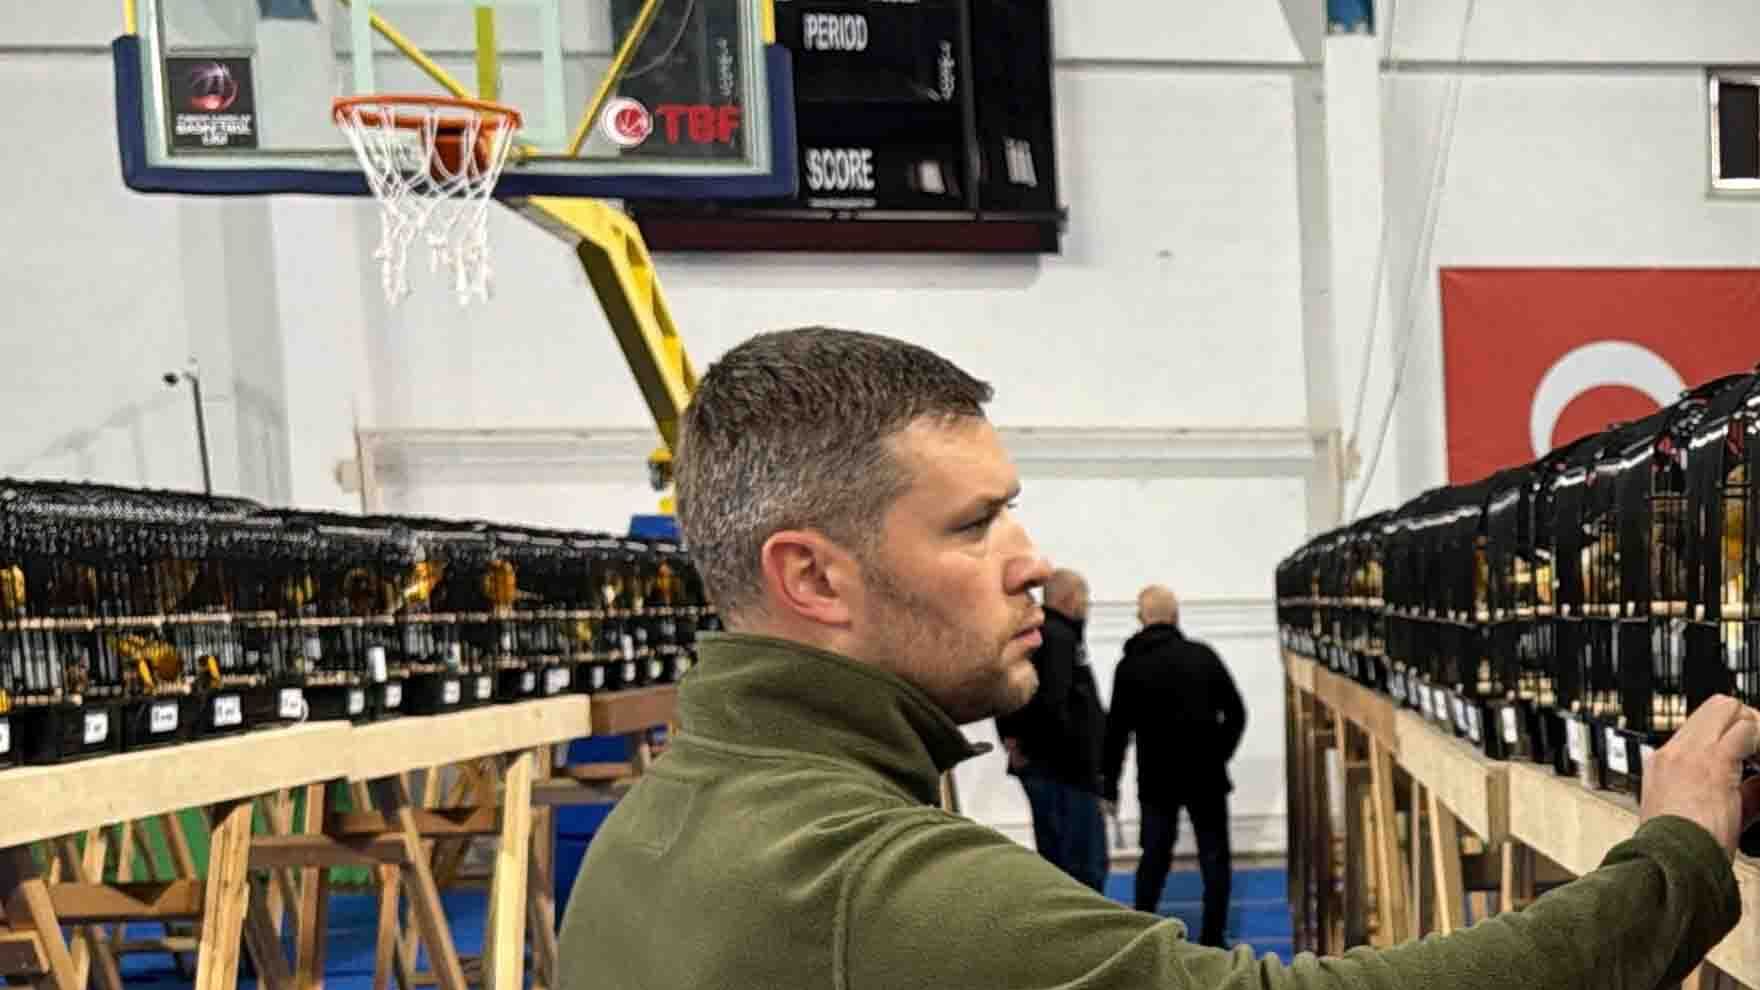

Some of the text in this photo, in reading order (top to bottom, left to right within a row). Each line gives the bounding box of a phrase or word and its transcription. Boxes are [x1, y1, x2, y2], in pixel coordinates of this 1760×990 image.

[803, 12, 868, 51] PERIOD
[656, 103, 742, 144] TBF
[806, 148, 875, 192] SCORE
